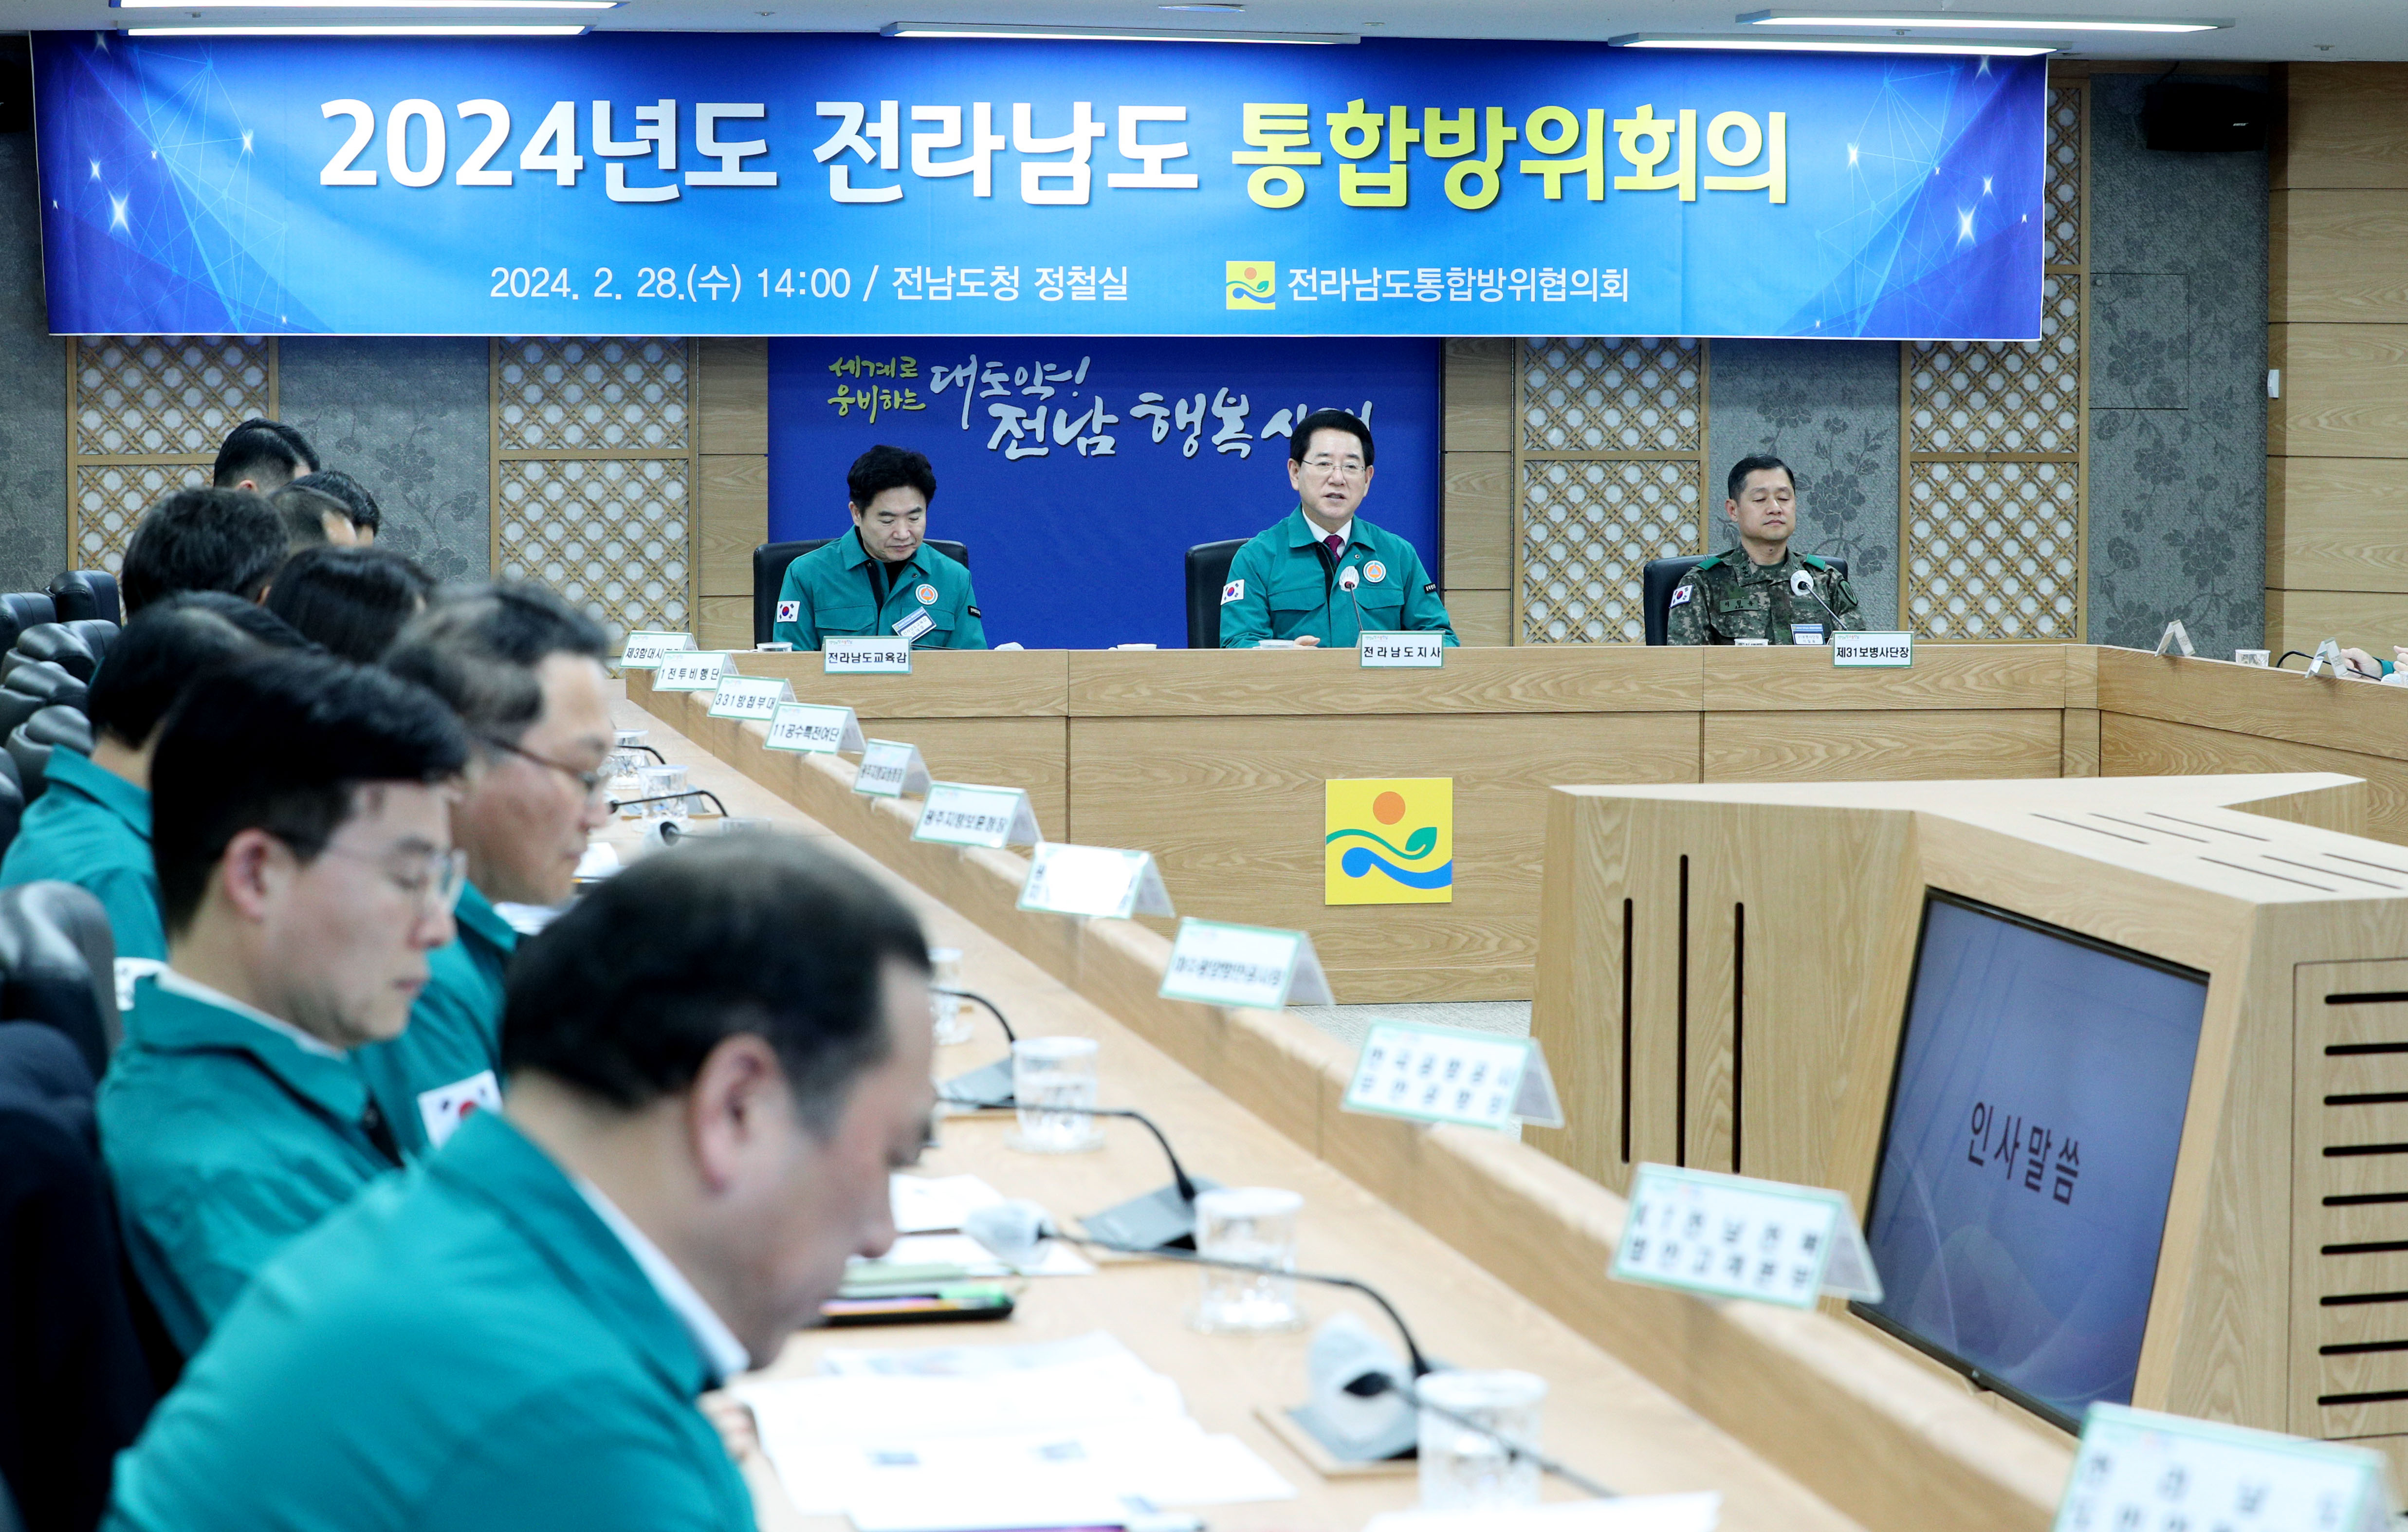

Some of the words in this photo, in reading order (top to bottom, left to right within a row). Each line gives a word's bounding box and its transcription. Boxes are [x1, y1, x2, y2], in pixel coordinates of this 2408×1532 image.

[320, 99, 776, 202] 2024년도
[813, 101, 1198, 205] 전라남도
[1232, 99, 1786, 209] 통합방위회의
[490, 267, 578, 300] 2024.
[594, 267, 622, 300] 2.
[638, 264, 741, 302] 28.(수)
[758, 268, 850, 298] 14:00
[892, 266, 1019, 301] 전남도청
[1034, 266, 1127, 301] 정철실
[1287, 267, 1628, 302] 전라남도통합방위협의회
[829, 355, 919, 378] 세계로
[828, 385, 926, 424] 웅비하는
[930, 354, 1091, 430] 대도약!
[987, 395, 1119, 460] 전남
[1130, 388, 1253, 459] 행복
[828, 652, 907, 664] 전라남도교육감
[1364, 646, 1441, 658] 전라남도지사
[1837, 647, 1910, 658] 제31보병사단장
[1967, 1102, 2080, 1205] 인사말씀
